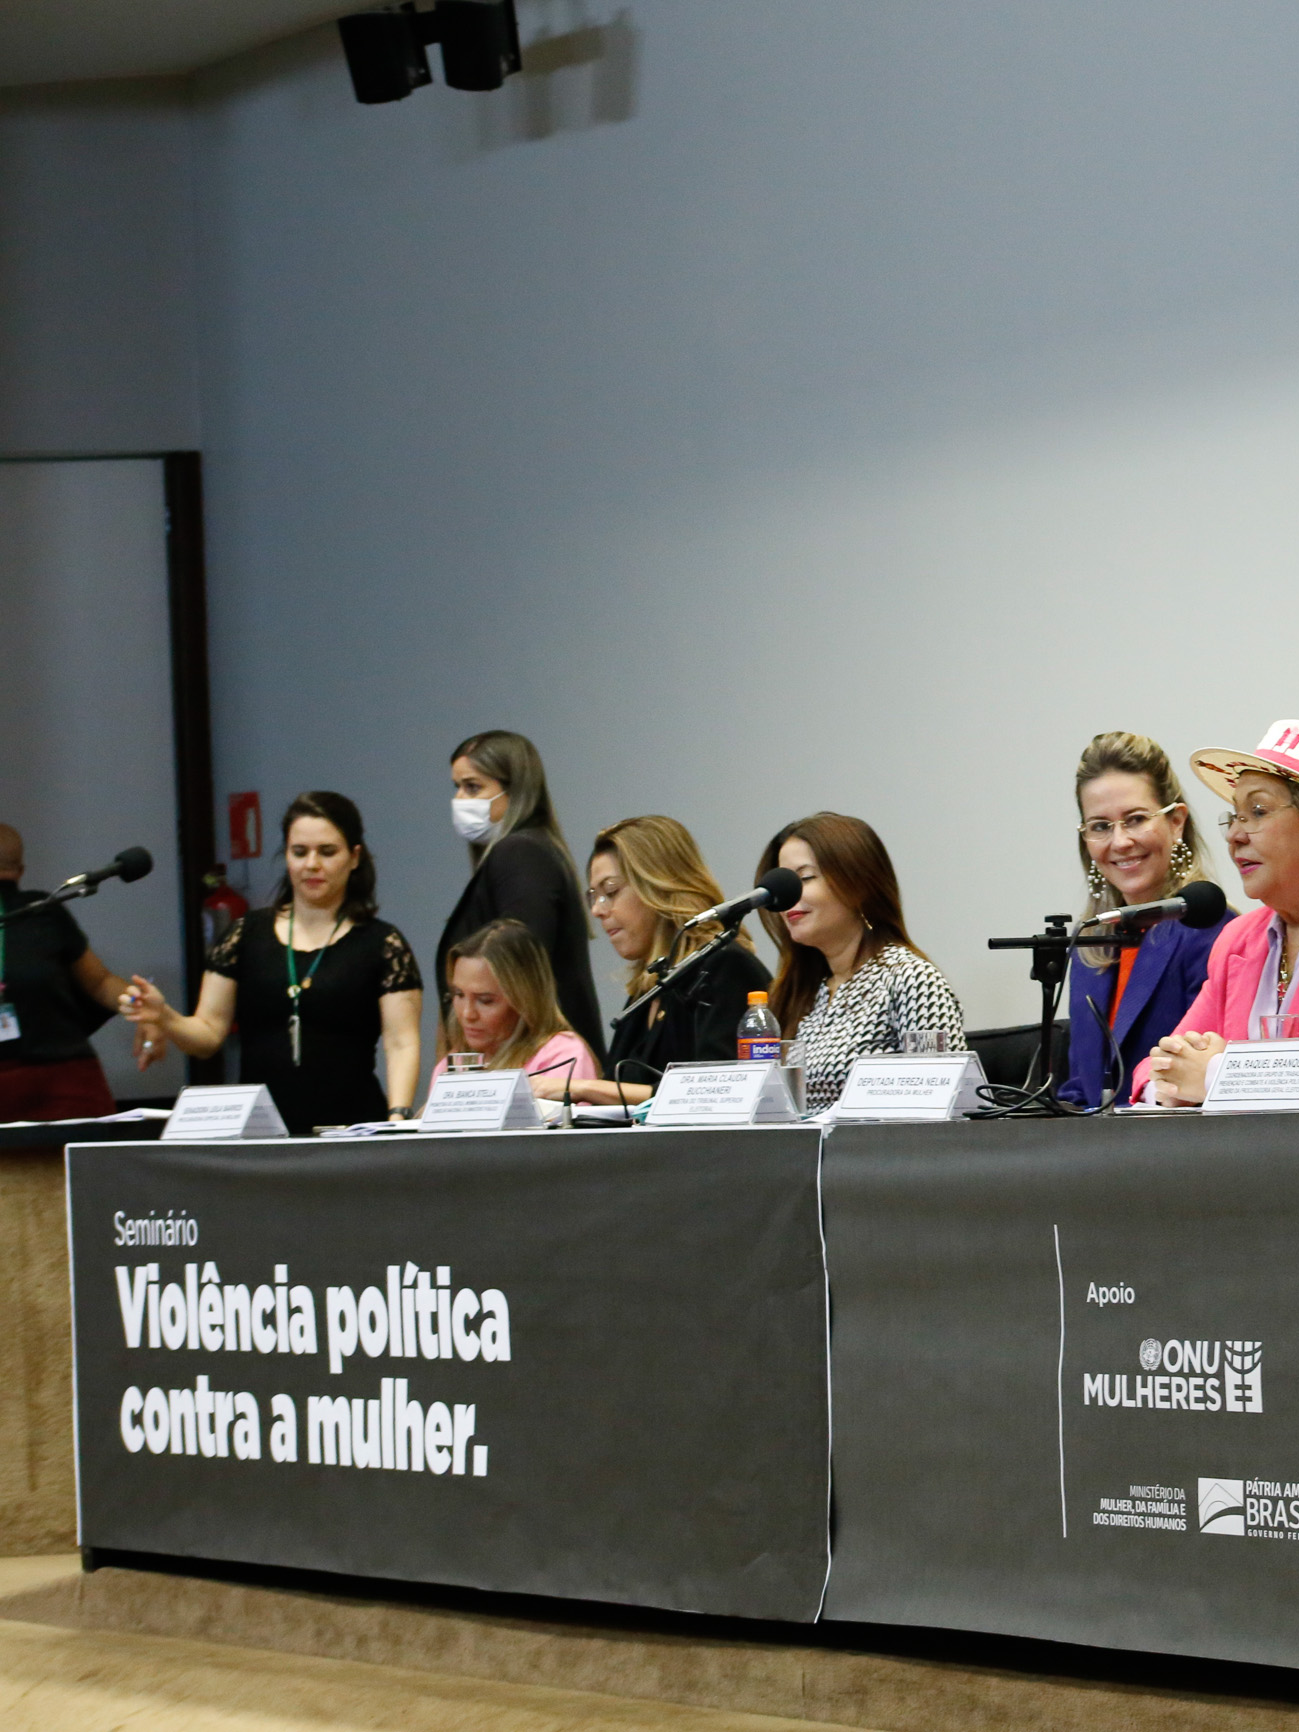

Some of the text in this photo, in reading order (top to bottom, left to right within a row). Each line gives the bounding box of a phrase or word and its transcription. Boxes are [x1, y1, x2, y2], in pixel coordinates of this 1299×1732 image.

[1244, 1059, 1271, 1068] RAQUEL
[857, 1077, 951, 1086] DEPUTADA TEREZA NELMA
[114, 1211, 198, 1246] Seminário
[1086, 1282, 1135, 1307] Apoio
[115, 1261, 511, 1374] Violência política
[1163, 1339, 1221, 1374] ONU
[1083, 1373, 1222, 1412] MULHERES
[120, 1375, 489, 1476] contra a mulher.
[1129, 1484, 1186, 1500] MINISTÉRIO DA
[1246, 1477, 1282, 1496] PÁTRIA
[1100, 1498, 1186, 1516] MULHER, DA FAMÍLIA E
[1093, 1512, 1187, 1531] DOS DIREITOS HUMANOS
[1248, 1528, 1284, 1540] GOVERNO
